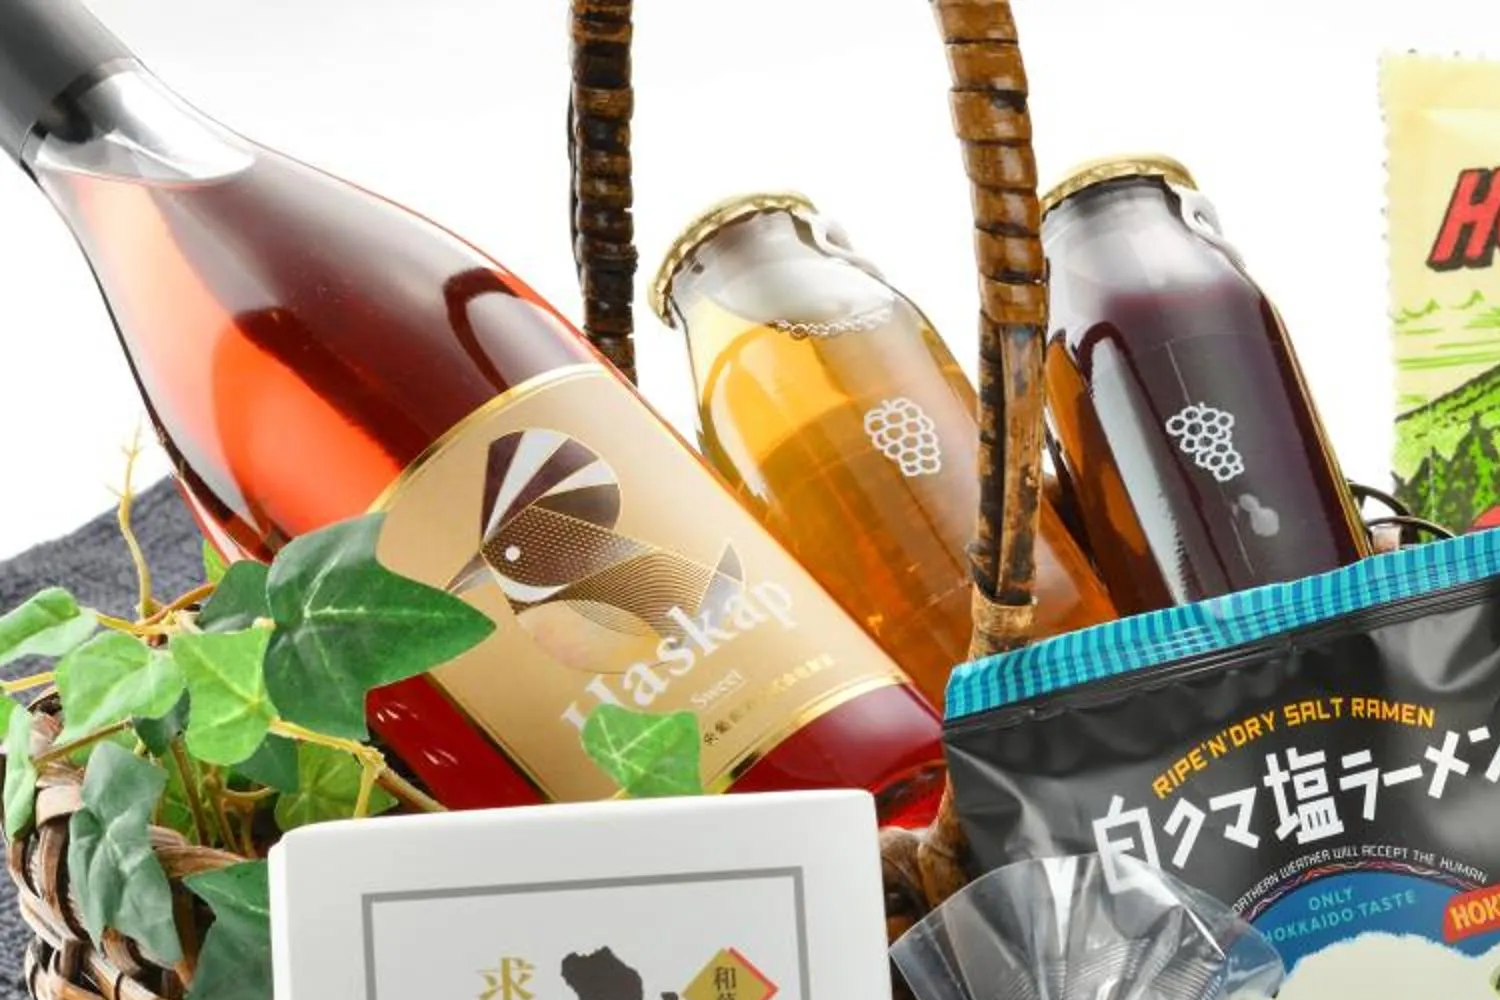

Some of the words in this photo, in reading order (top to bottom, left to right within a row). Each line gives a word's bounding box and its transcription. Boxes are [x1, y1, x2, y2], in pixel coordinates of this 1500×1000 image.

[1283, 697, 1343, 727] SALT
[1351, 697, 1435, 728] RAMEN
[1413, 850, 1436, 865] THE
[1308, 886, 1354, 912] ONLY
[1262, 908, 1353, 943] HOKKAIDO
[1360, 889, 1416, 917] TASTE
